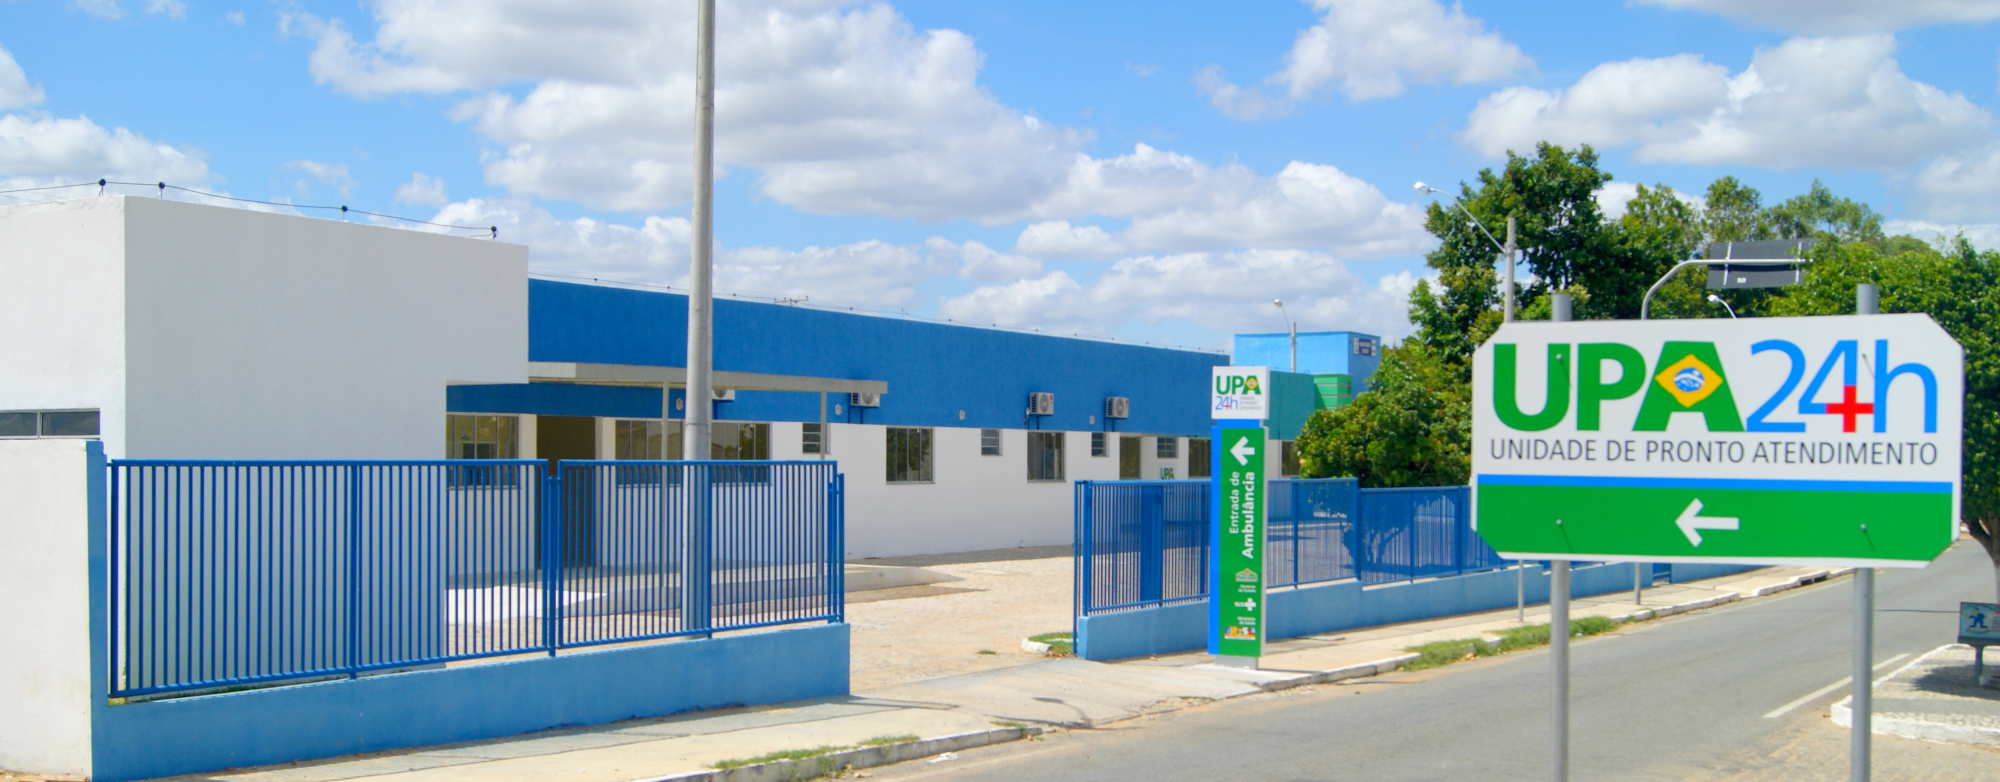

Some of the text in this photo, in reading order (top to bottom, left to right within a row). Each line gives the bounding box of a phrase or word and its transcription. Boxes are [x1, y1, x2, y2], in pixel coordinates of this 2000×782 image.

[1216, 375, 1261, 395] UPA
[1492, 339, 1938, 433] UPA 24h
[1214, 395, 1239, 410] 24h
[1490, 438, 1938, 466] UNIDADE DE PRONTO ATENDIMENTO
[1160, 467, 1175, 480] UPA
[1229, 471, 1240, 534] Entrada de
[1241, 471, 1255, 559] Ambulância
